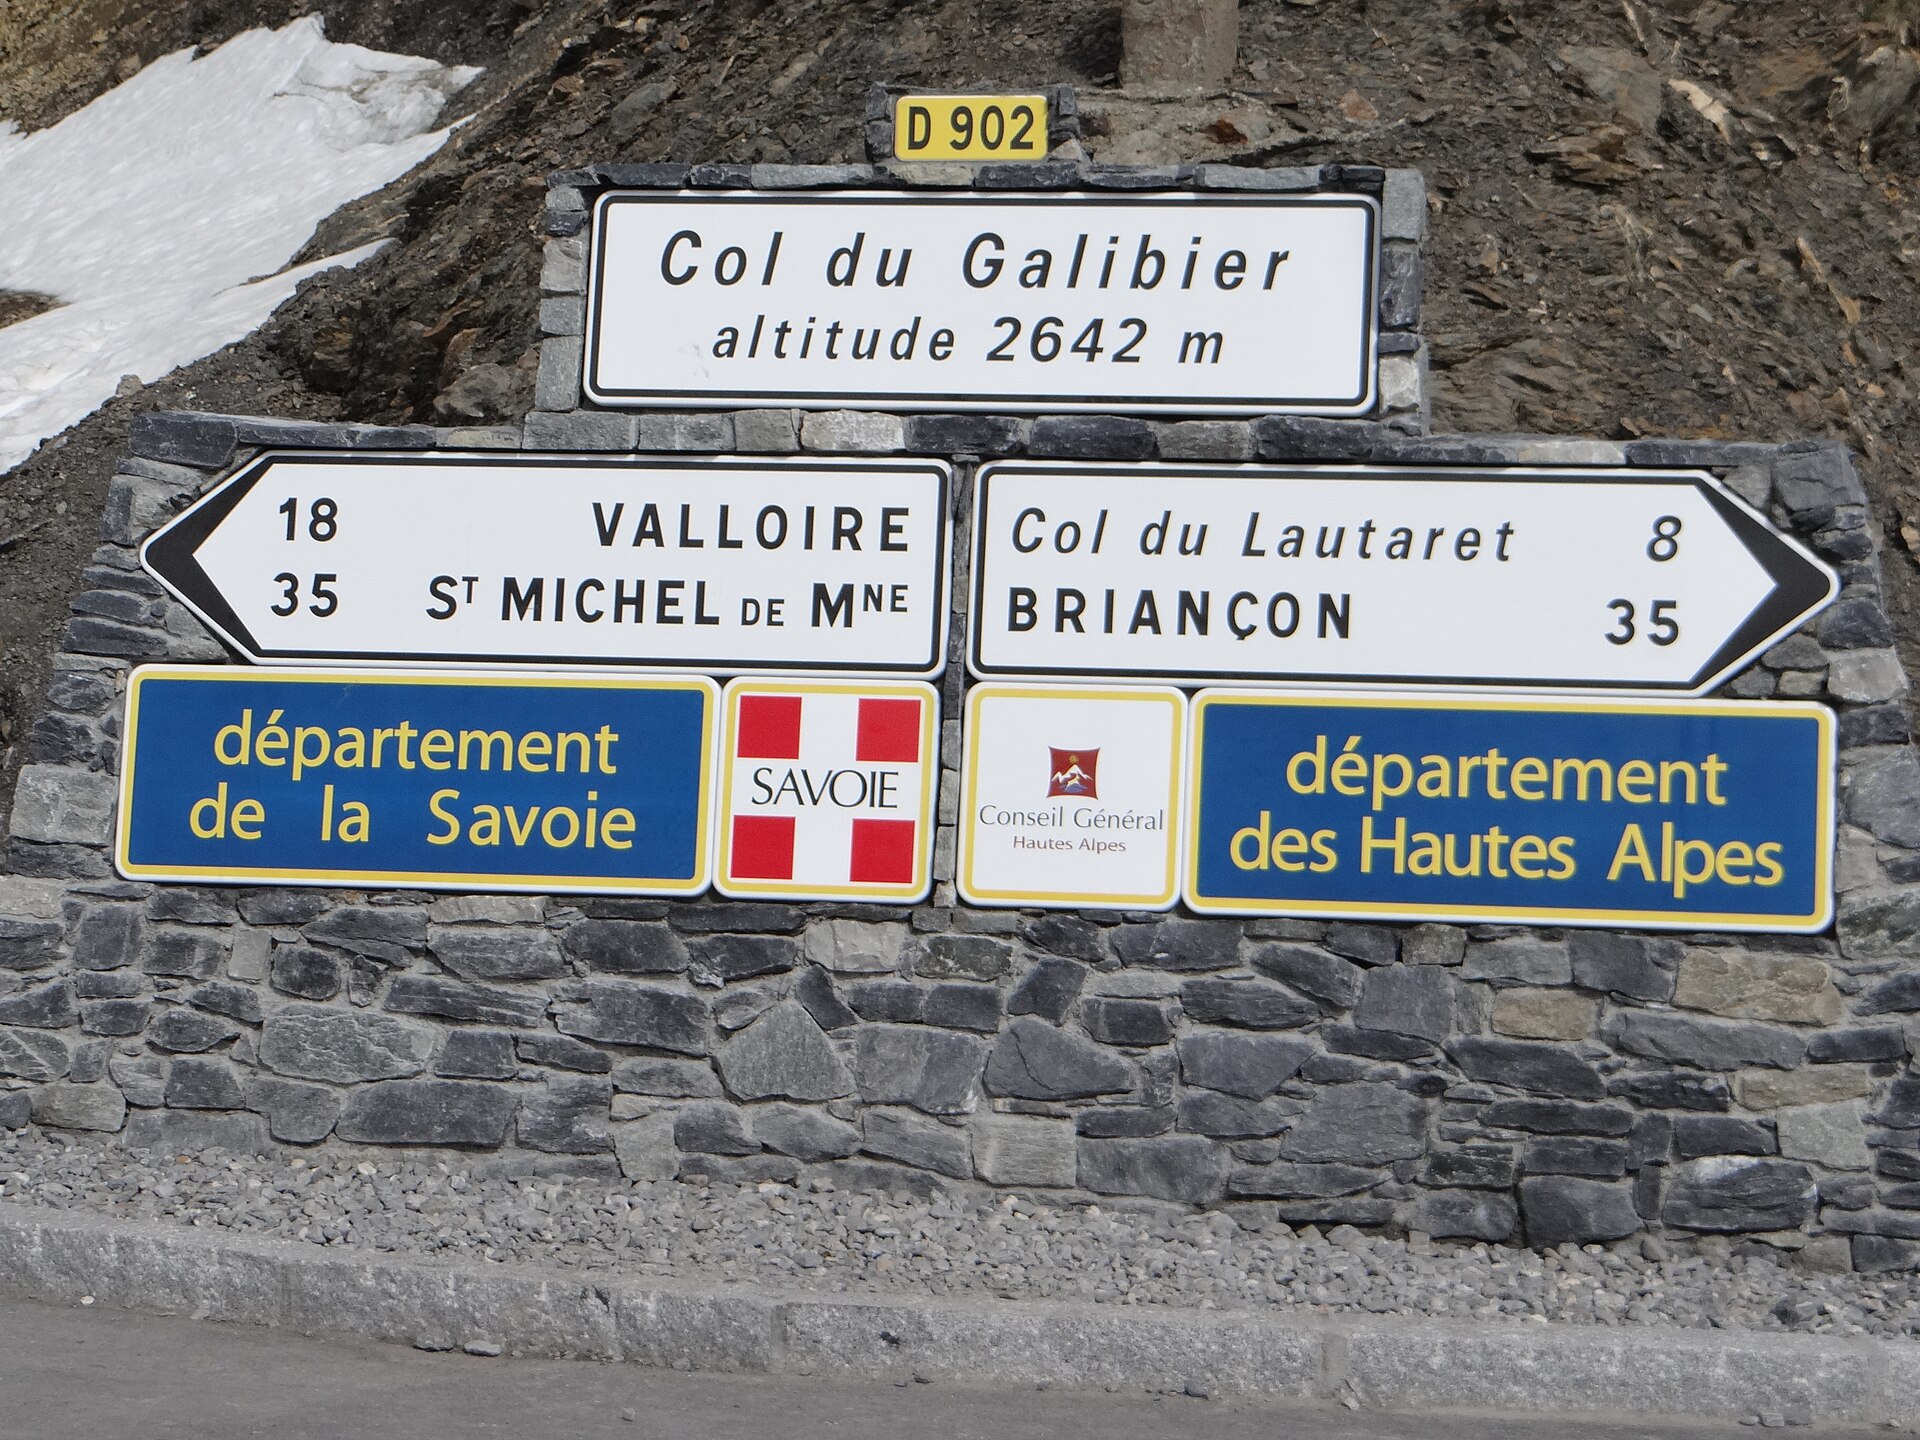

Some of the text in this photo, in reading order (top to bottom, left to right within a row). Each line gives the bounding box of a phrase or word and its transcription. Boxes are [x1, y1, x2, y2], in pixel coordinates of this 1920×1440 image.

[907, 104, 1034, 151] D 902
[660, 229, 1290, 291] Col du Galibier
[712, 314, 1224, 364] altitude 2642 m
[279, 497, 910, 552] 18 VALLOIRE
[1012, 507, 1683, 563] Col du Lautaret 8
[270, 572, 338, 618] 35
[501, 576, 720, 626] MICHEL
[740, 597, 785, 627] DE
[1007, 586, 1679, 647] BRIANÇON 35
[214, 708, 620, 780] département
[752, 768, 898, 808] SAVOIE
[1286, 734, 1729, 812] département
[189, 781, 636, 850] de la Savoie
[979, 804, 1163, 830] Conseil Général
[1013, 835, 1127, 855] Hautes Alpes
[1229, 810, 1785, 899] des Hautes Alpes
